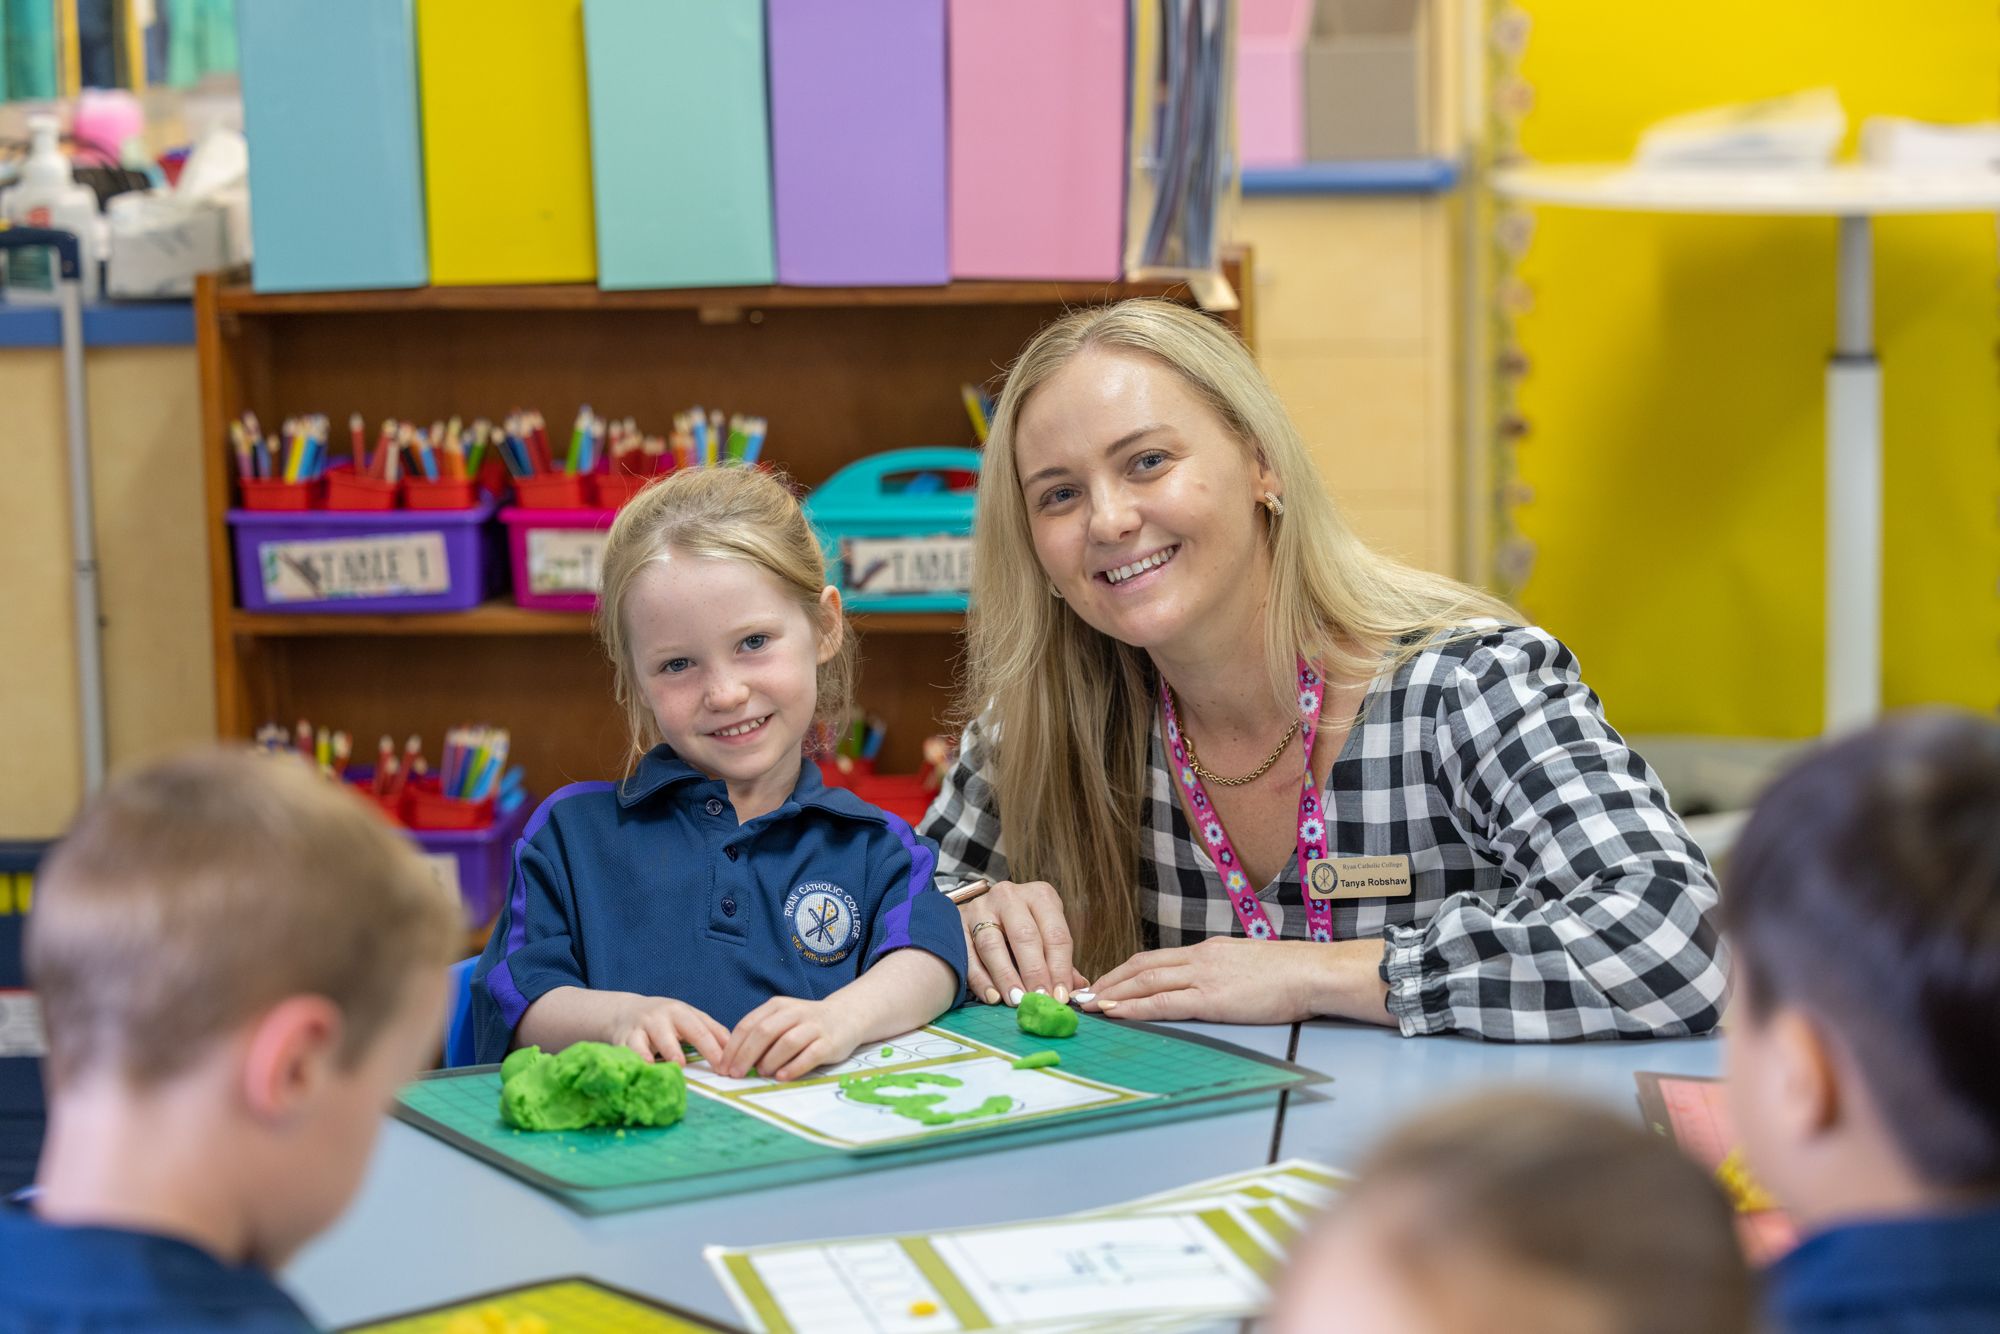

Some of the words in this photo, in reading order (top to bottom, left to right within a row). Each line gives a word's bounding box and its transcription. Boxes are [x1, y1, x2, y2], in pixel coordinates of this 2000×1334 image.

[320, 545, 401, 583] TABLE
[1342, 863, 1357, 872] Ryan
[1381, 861, 1403, 869] College
[1340, 879, 1366, 888] Tanya
[1367, 877, 1408, 886] Robshaw
[784, 893, 800, 917] RYAN
[798, 883, 843, 896] CATHOLIC
[843, 895, 861, 939] COLLEGE
